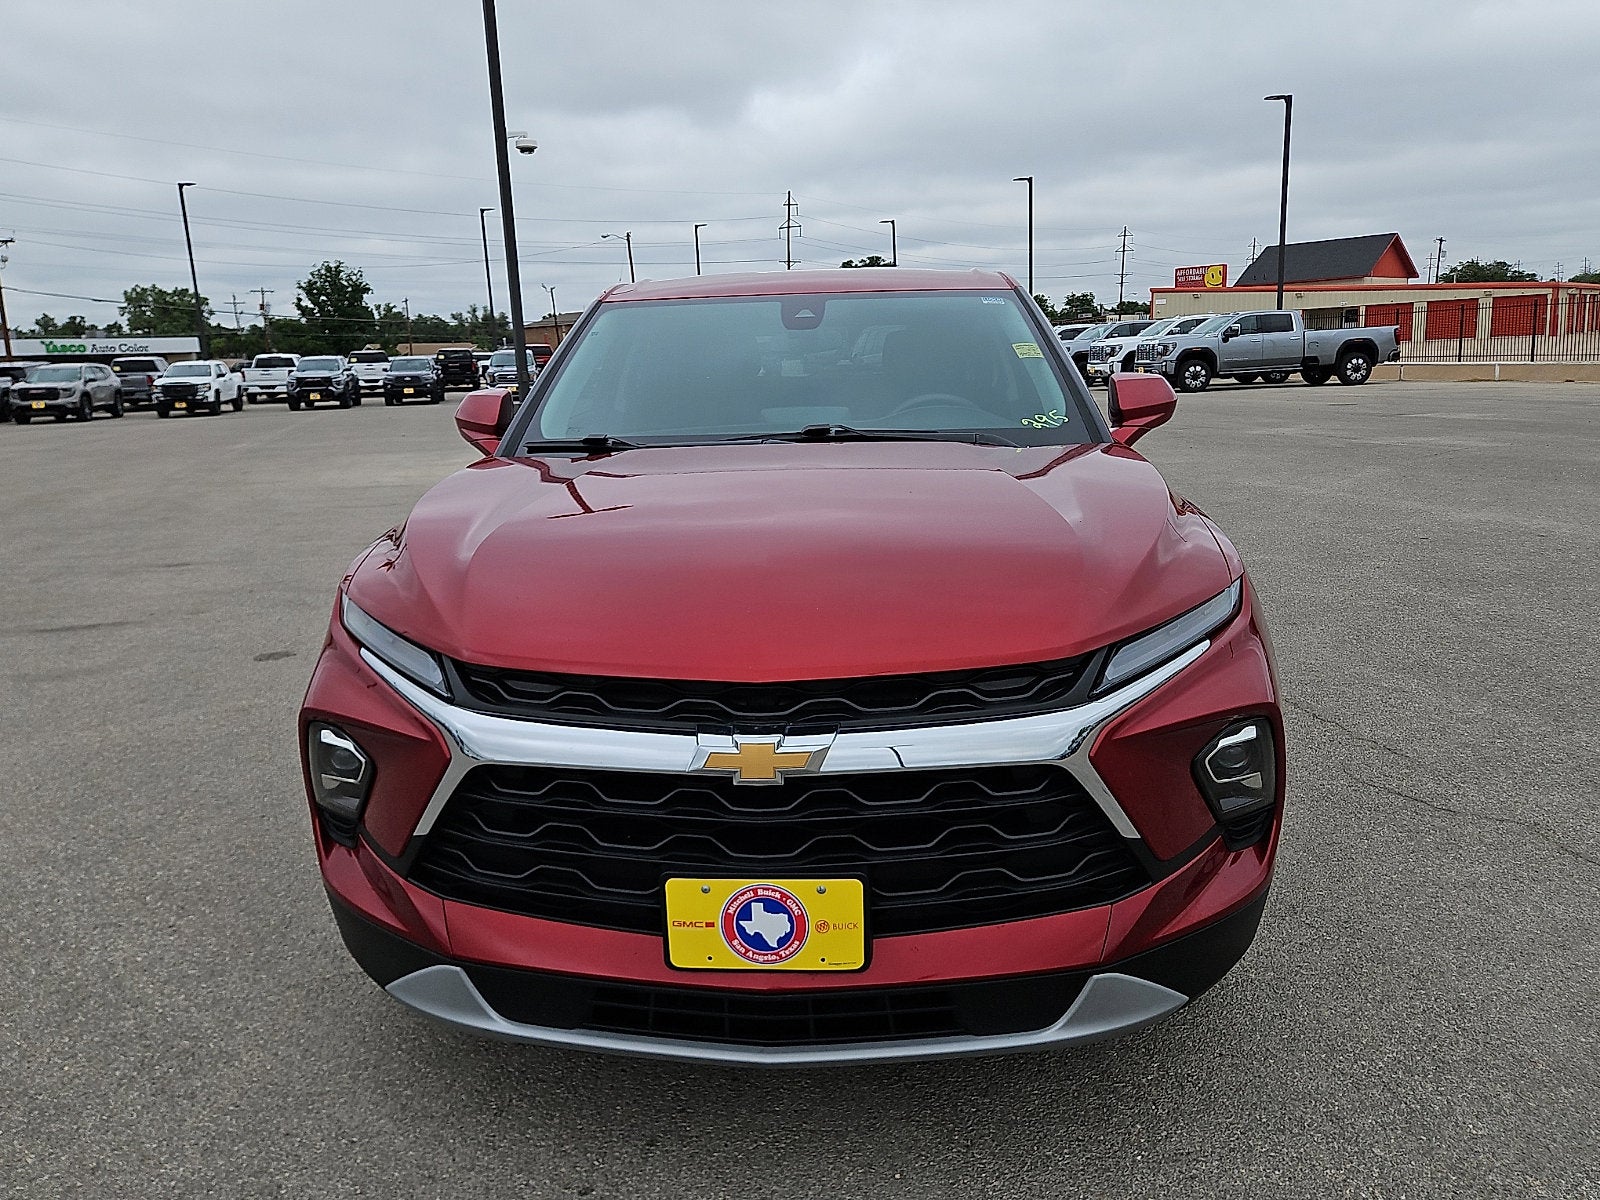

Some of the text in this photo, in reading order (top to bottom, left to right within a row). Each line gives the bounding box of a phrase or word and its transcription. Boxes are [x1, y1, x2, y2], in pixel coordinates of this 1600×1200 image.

[91, 343, 116, 353] Auto
[118, 343, 149, 353] Color
[727, 888, 802, 916] Mitchell Buick GMC
[672, 920, 704, 928] GMC
[832, 922, 859, 930] BUICK
[731, 939, 746, 954] San
[779, 939, 800, 958] Texas
